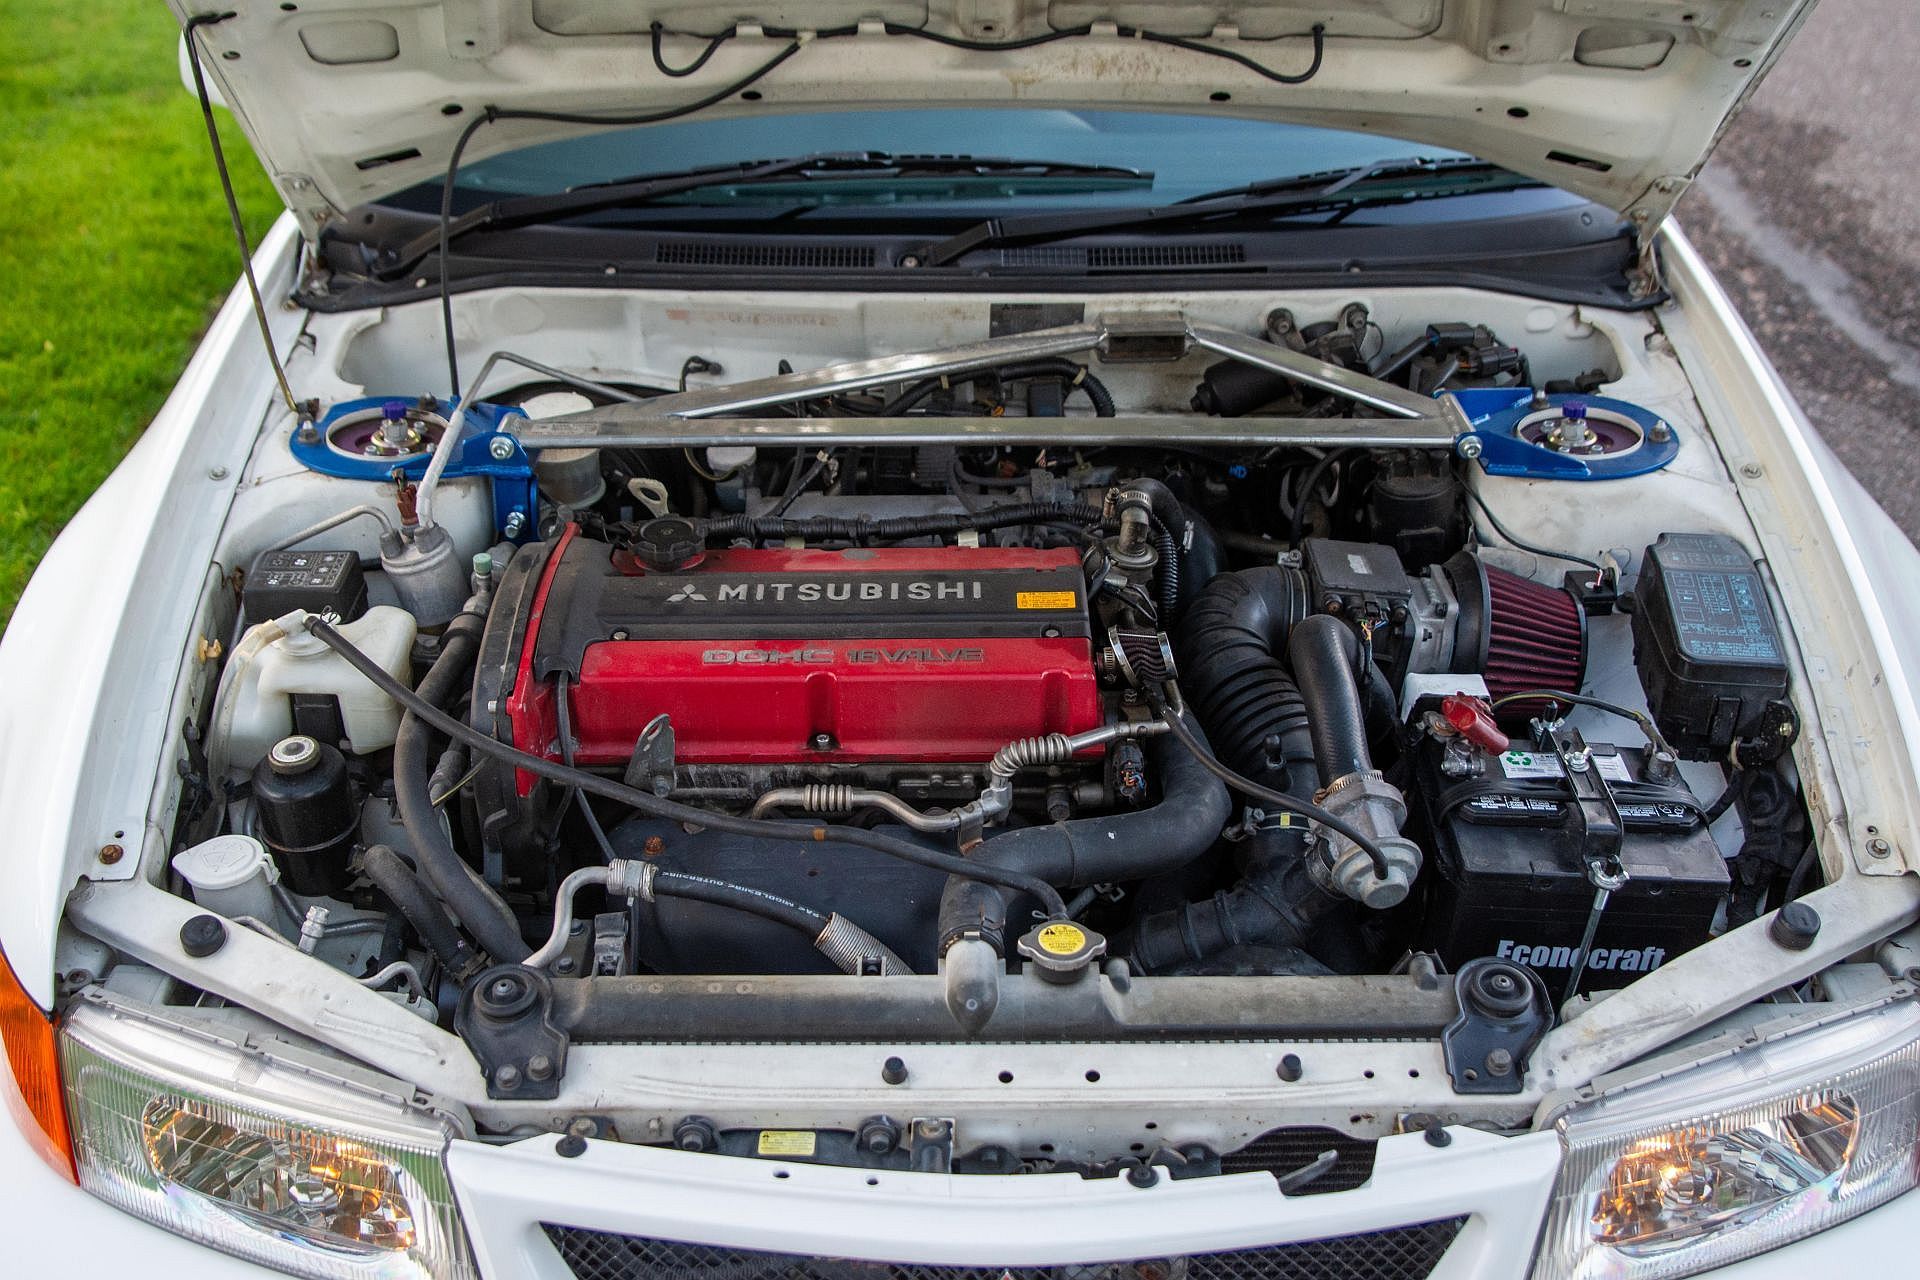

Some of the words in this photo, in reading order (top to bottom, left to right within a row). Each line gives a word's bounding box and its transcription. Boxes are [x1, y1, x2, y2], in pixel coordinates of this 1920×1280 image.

[717, 581, 982, 601] MITSUBISHI
[702, 649, 835, 664] DOHC
[1496, 940, 1666, 972] Econocraft
